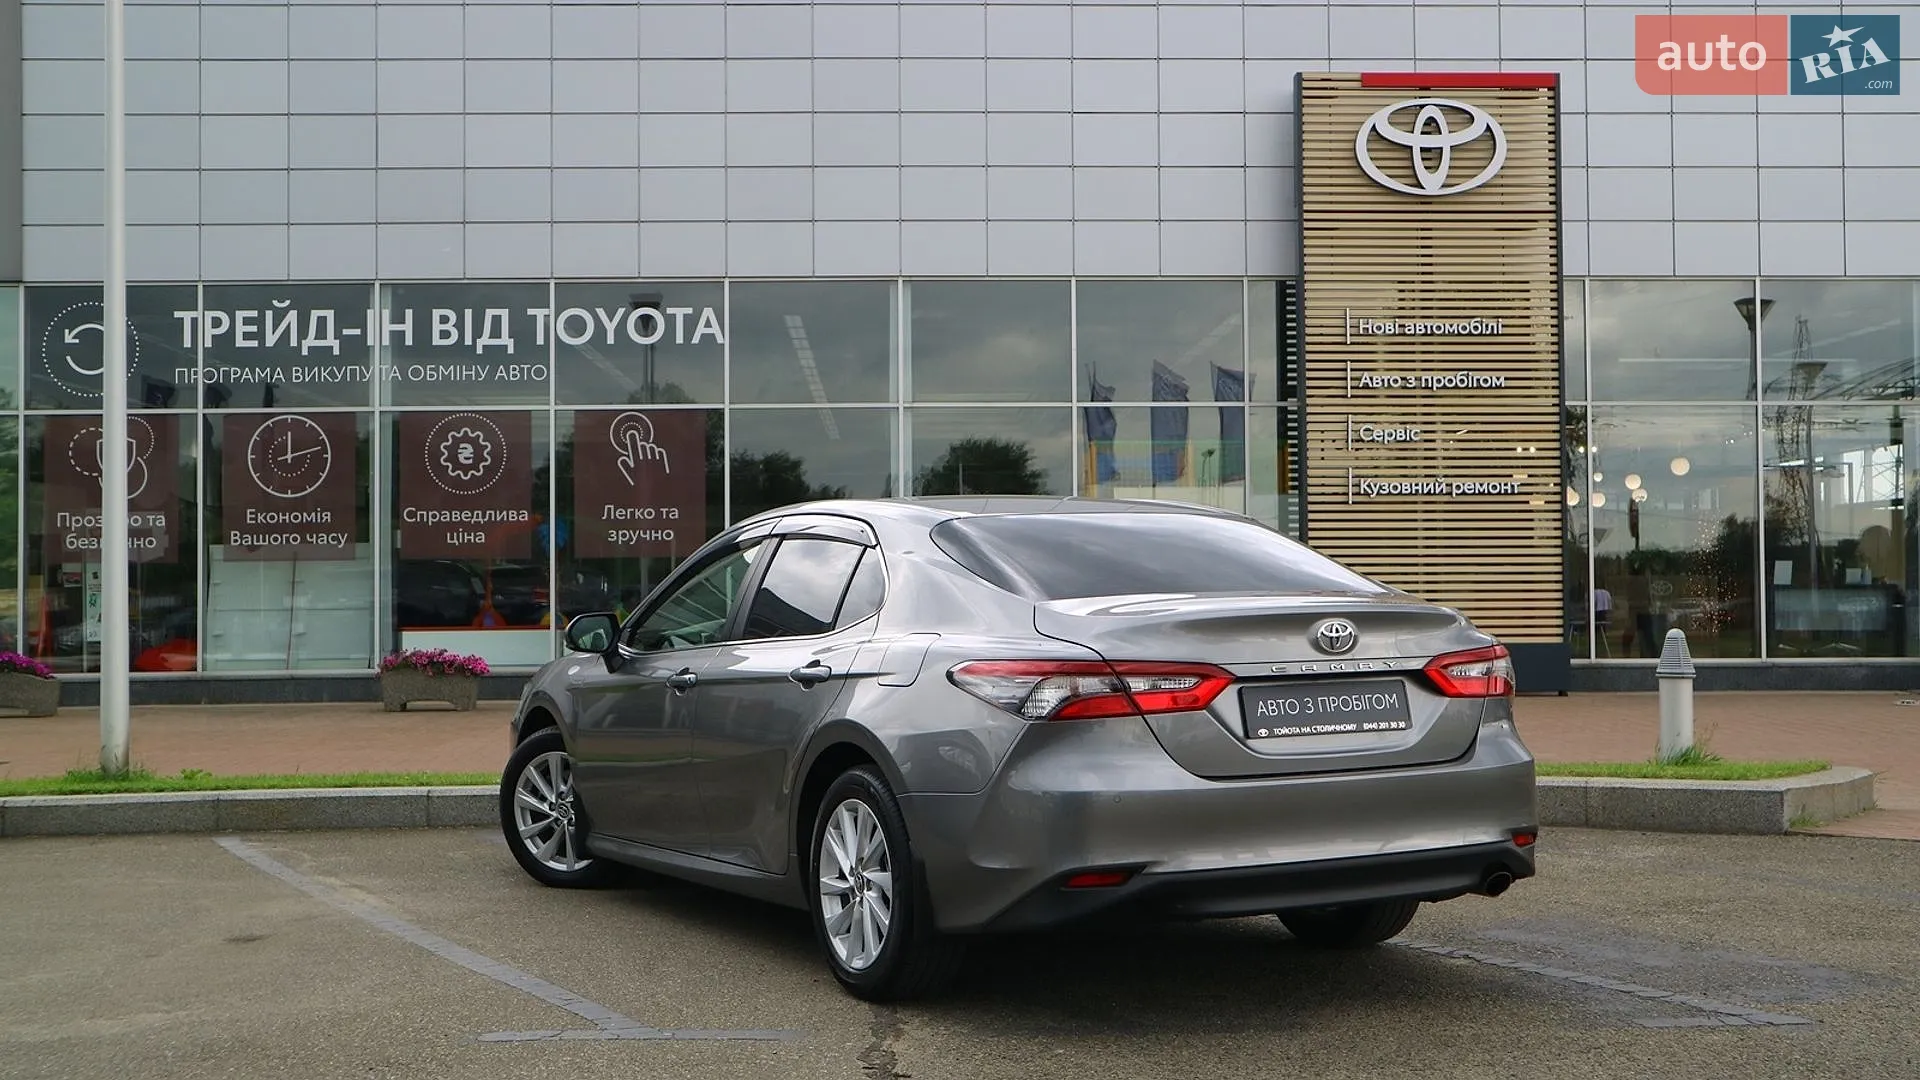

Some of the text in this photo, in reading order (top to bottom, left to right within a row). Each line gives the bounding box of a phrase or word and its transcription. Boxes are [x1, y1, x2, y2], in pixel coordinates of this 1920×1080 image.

[174, 299, 725, 355] ТРЕЙД-ІН ВІД TOYOTA
[1359, 318, 1502, 335] Нові автомобілі
[174, 364, 547, 384] ПРОГРАМА ВИКУПУ ТА ОБМІНУ АВТО
[1359, 371, 1505, 391] Авто з пробігом
[1359, 425, 1420, 444] Сервіс
[1360, 477, 1521, 498] Кузовний ремонт
[246, 508, 331, 524] Економія
[403, 507, 528, 526] Справедлива
[601, 504, 679, 520] Легко та
[146, 515, 165, 528] та
[230, 530, 348, 548] Вашого часу
[447, 528, 485, 546] ціна
[607, 529, 674, 544] зручно
[1271, 661, 1397, 673] CAMRY
[1257, 698, 1300, 717] АВТО
[1317, 693, 1399, 713] ПРОБІГОМ
[1273, 725, 1301, 736] ТОЙОТА
[1301, 725, 1311, 734] НА
